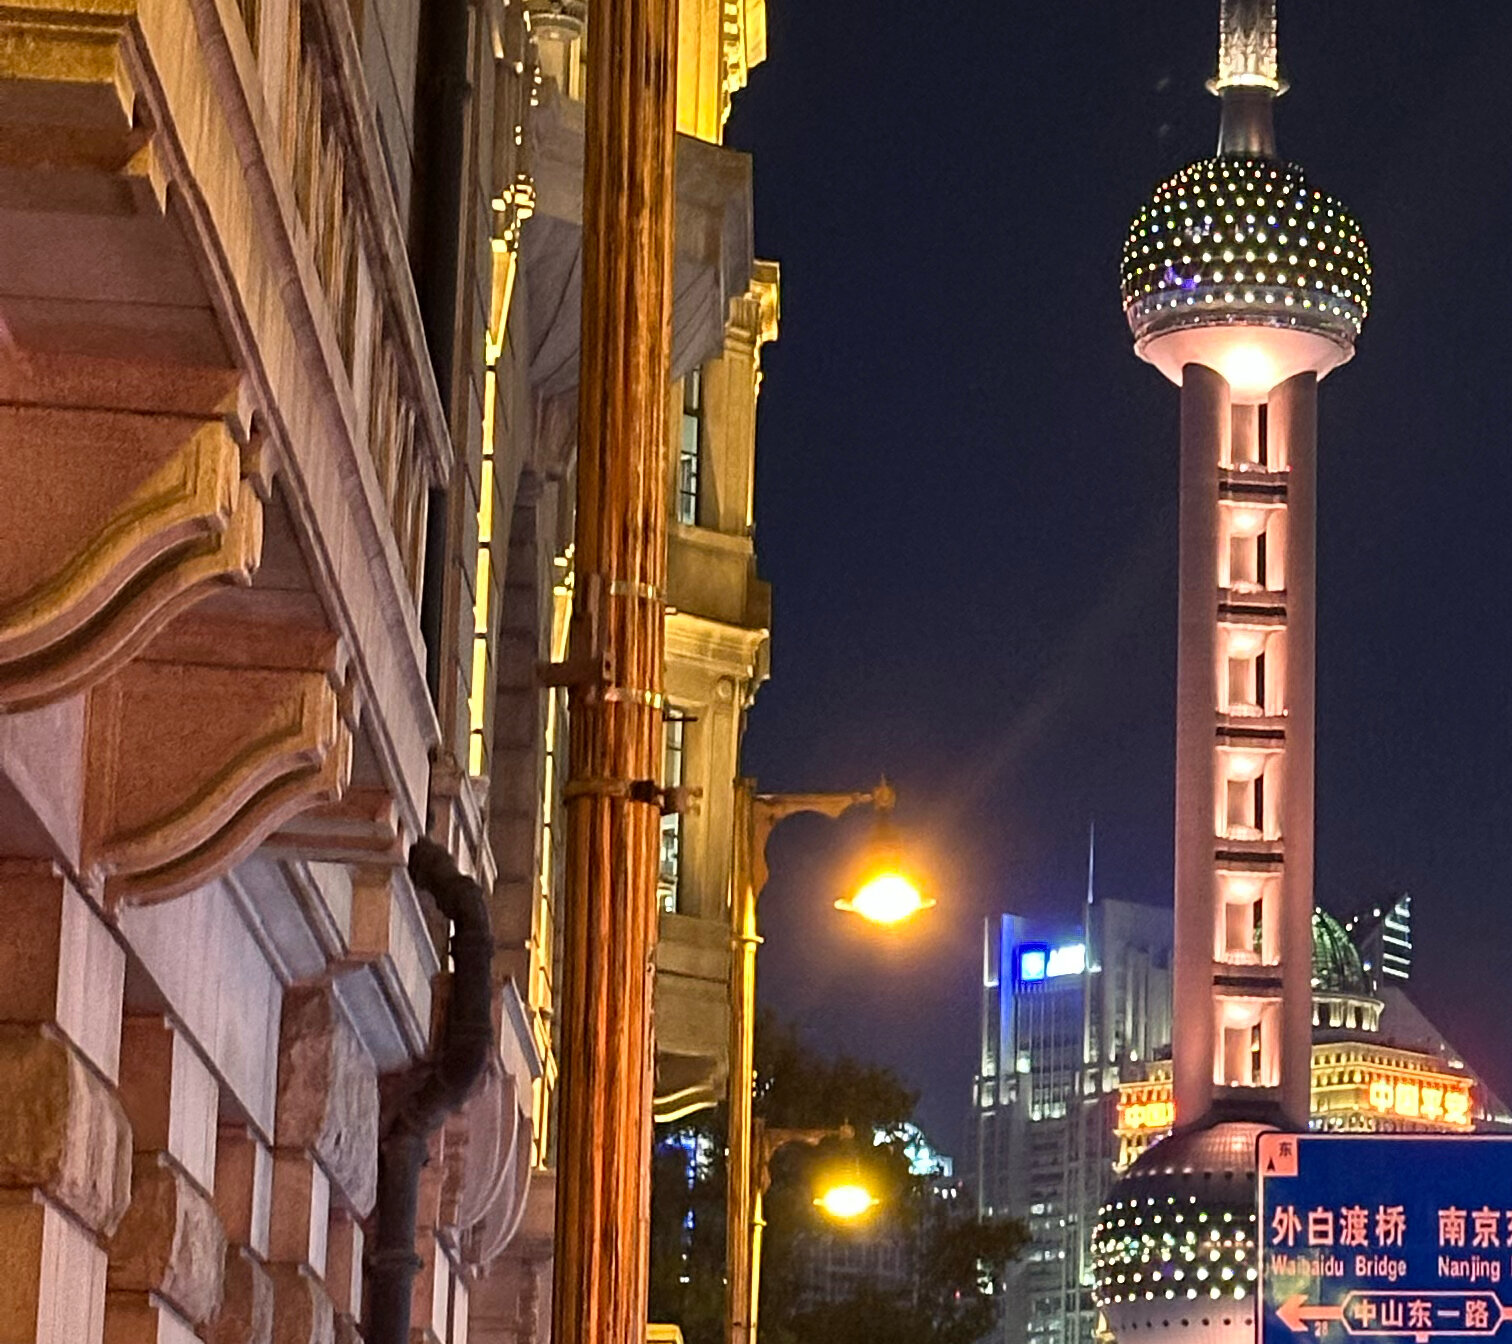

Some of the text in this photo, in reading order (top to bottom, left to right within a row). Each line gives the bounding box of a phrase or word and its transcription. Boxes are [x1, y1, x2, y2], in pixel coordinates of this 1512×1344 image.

[1278, 1141, 1293, 1156] 东
[1271, 1205, 1407, 1248] 外白渡桥
[1271, 1255, 1407, 1282] Waibaidu Bridge
[1437, 1256, 1501, 1282] Nanjing
[1353, 1299, 1490, 1329] 中山东一路
